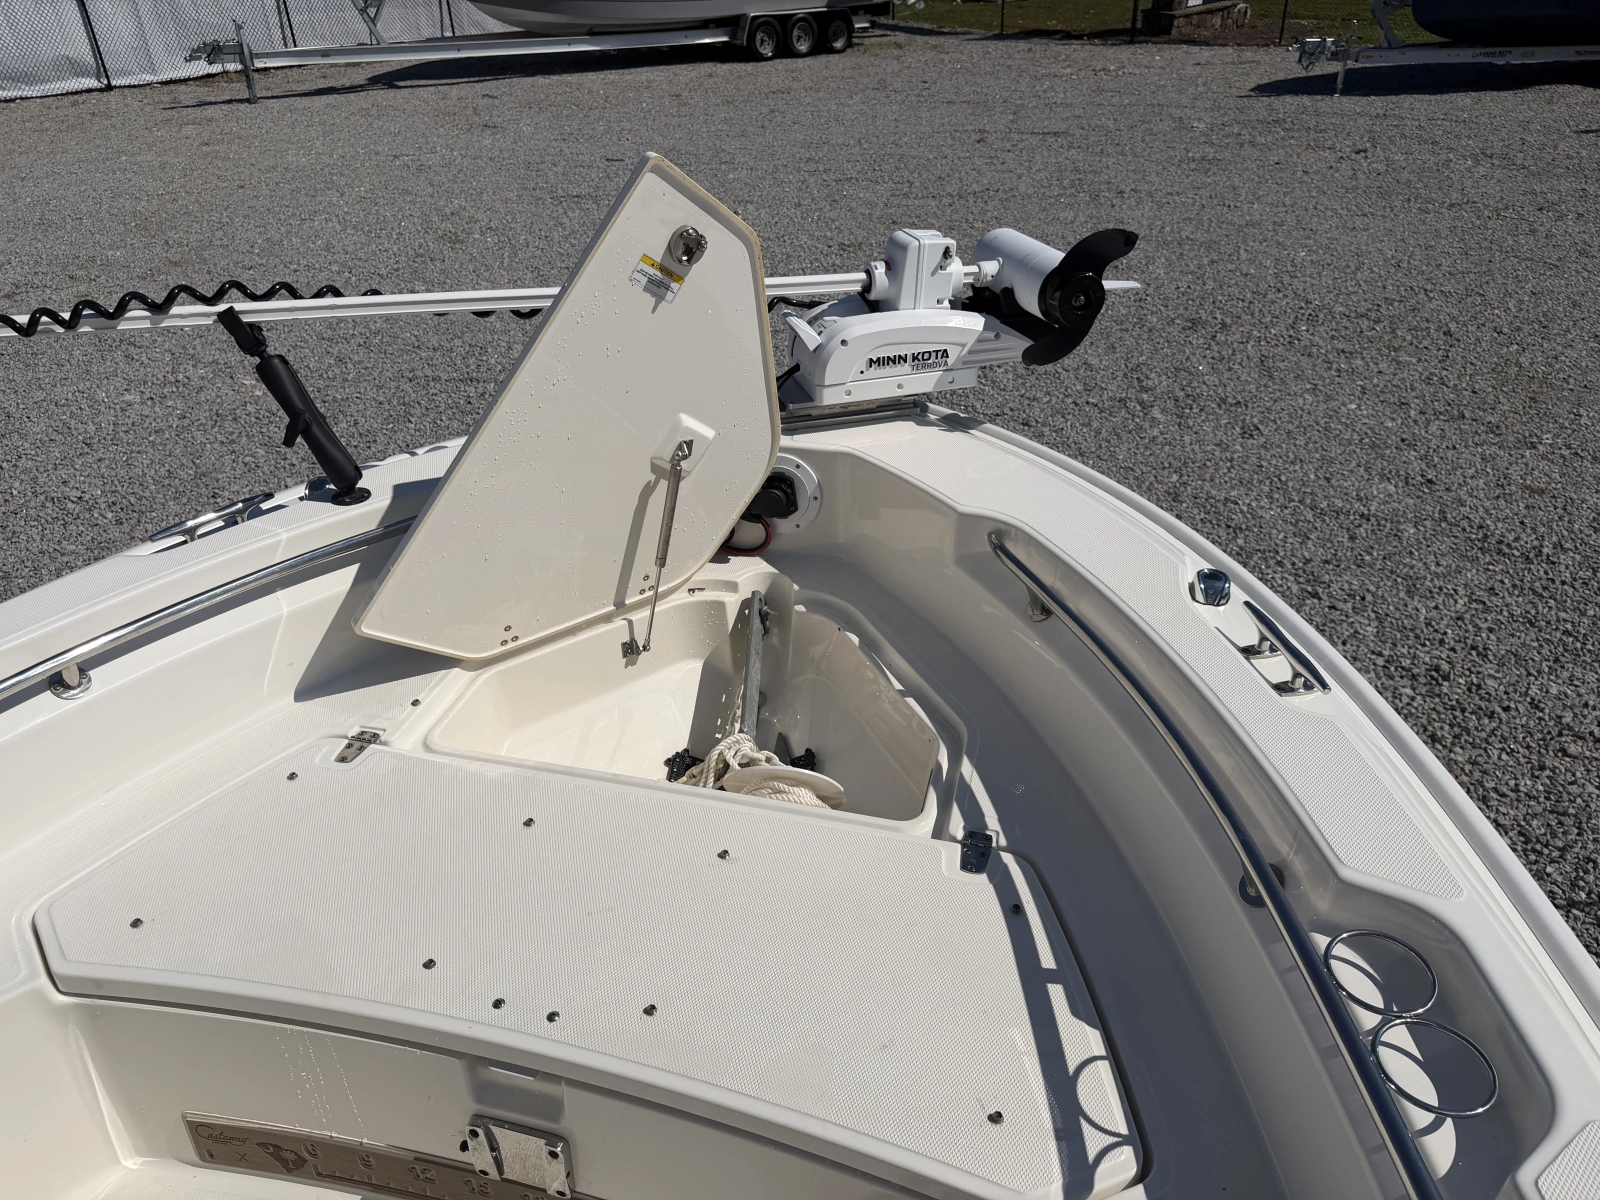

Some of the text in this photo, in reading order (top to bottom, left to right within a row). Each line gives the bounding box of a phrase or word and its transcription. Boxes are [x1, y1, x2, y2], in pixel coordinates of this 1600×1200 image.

[868, 348, 950, 369] MINN KOTA
[911, 360, 949, 372] TERROVA
[195, 1124, 250, 1147] Castaway
[302, 1142, 320, 1160] 6
[358, 1153, 375, 1170] 9
[408, 1164, 437, 1184] 12
[463, 1178, 493, 1197] 15
